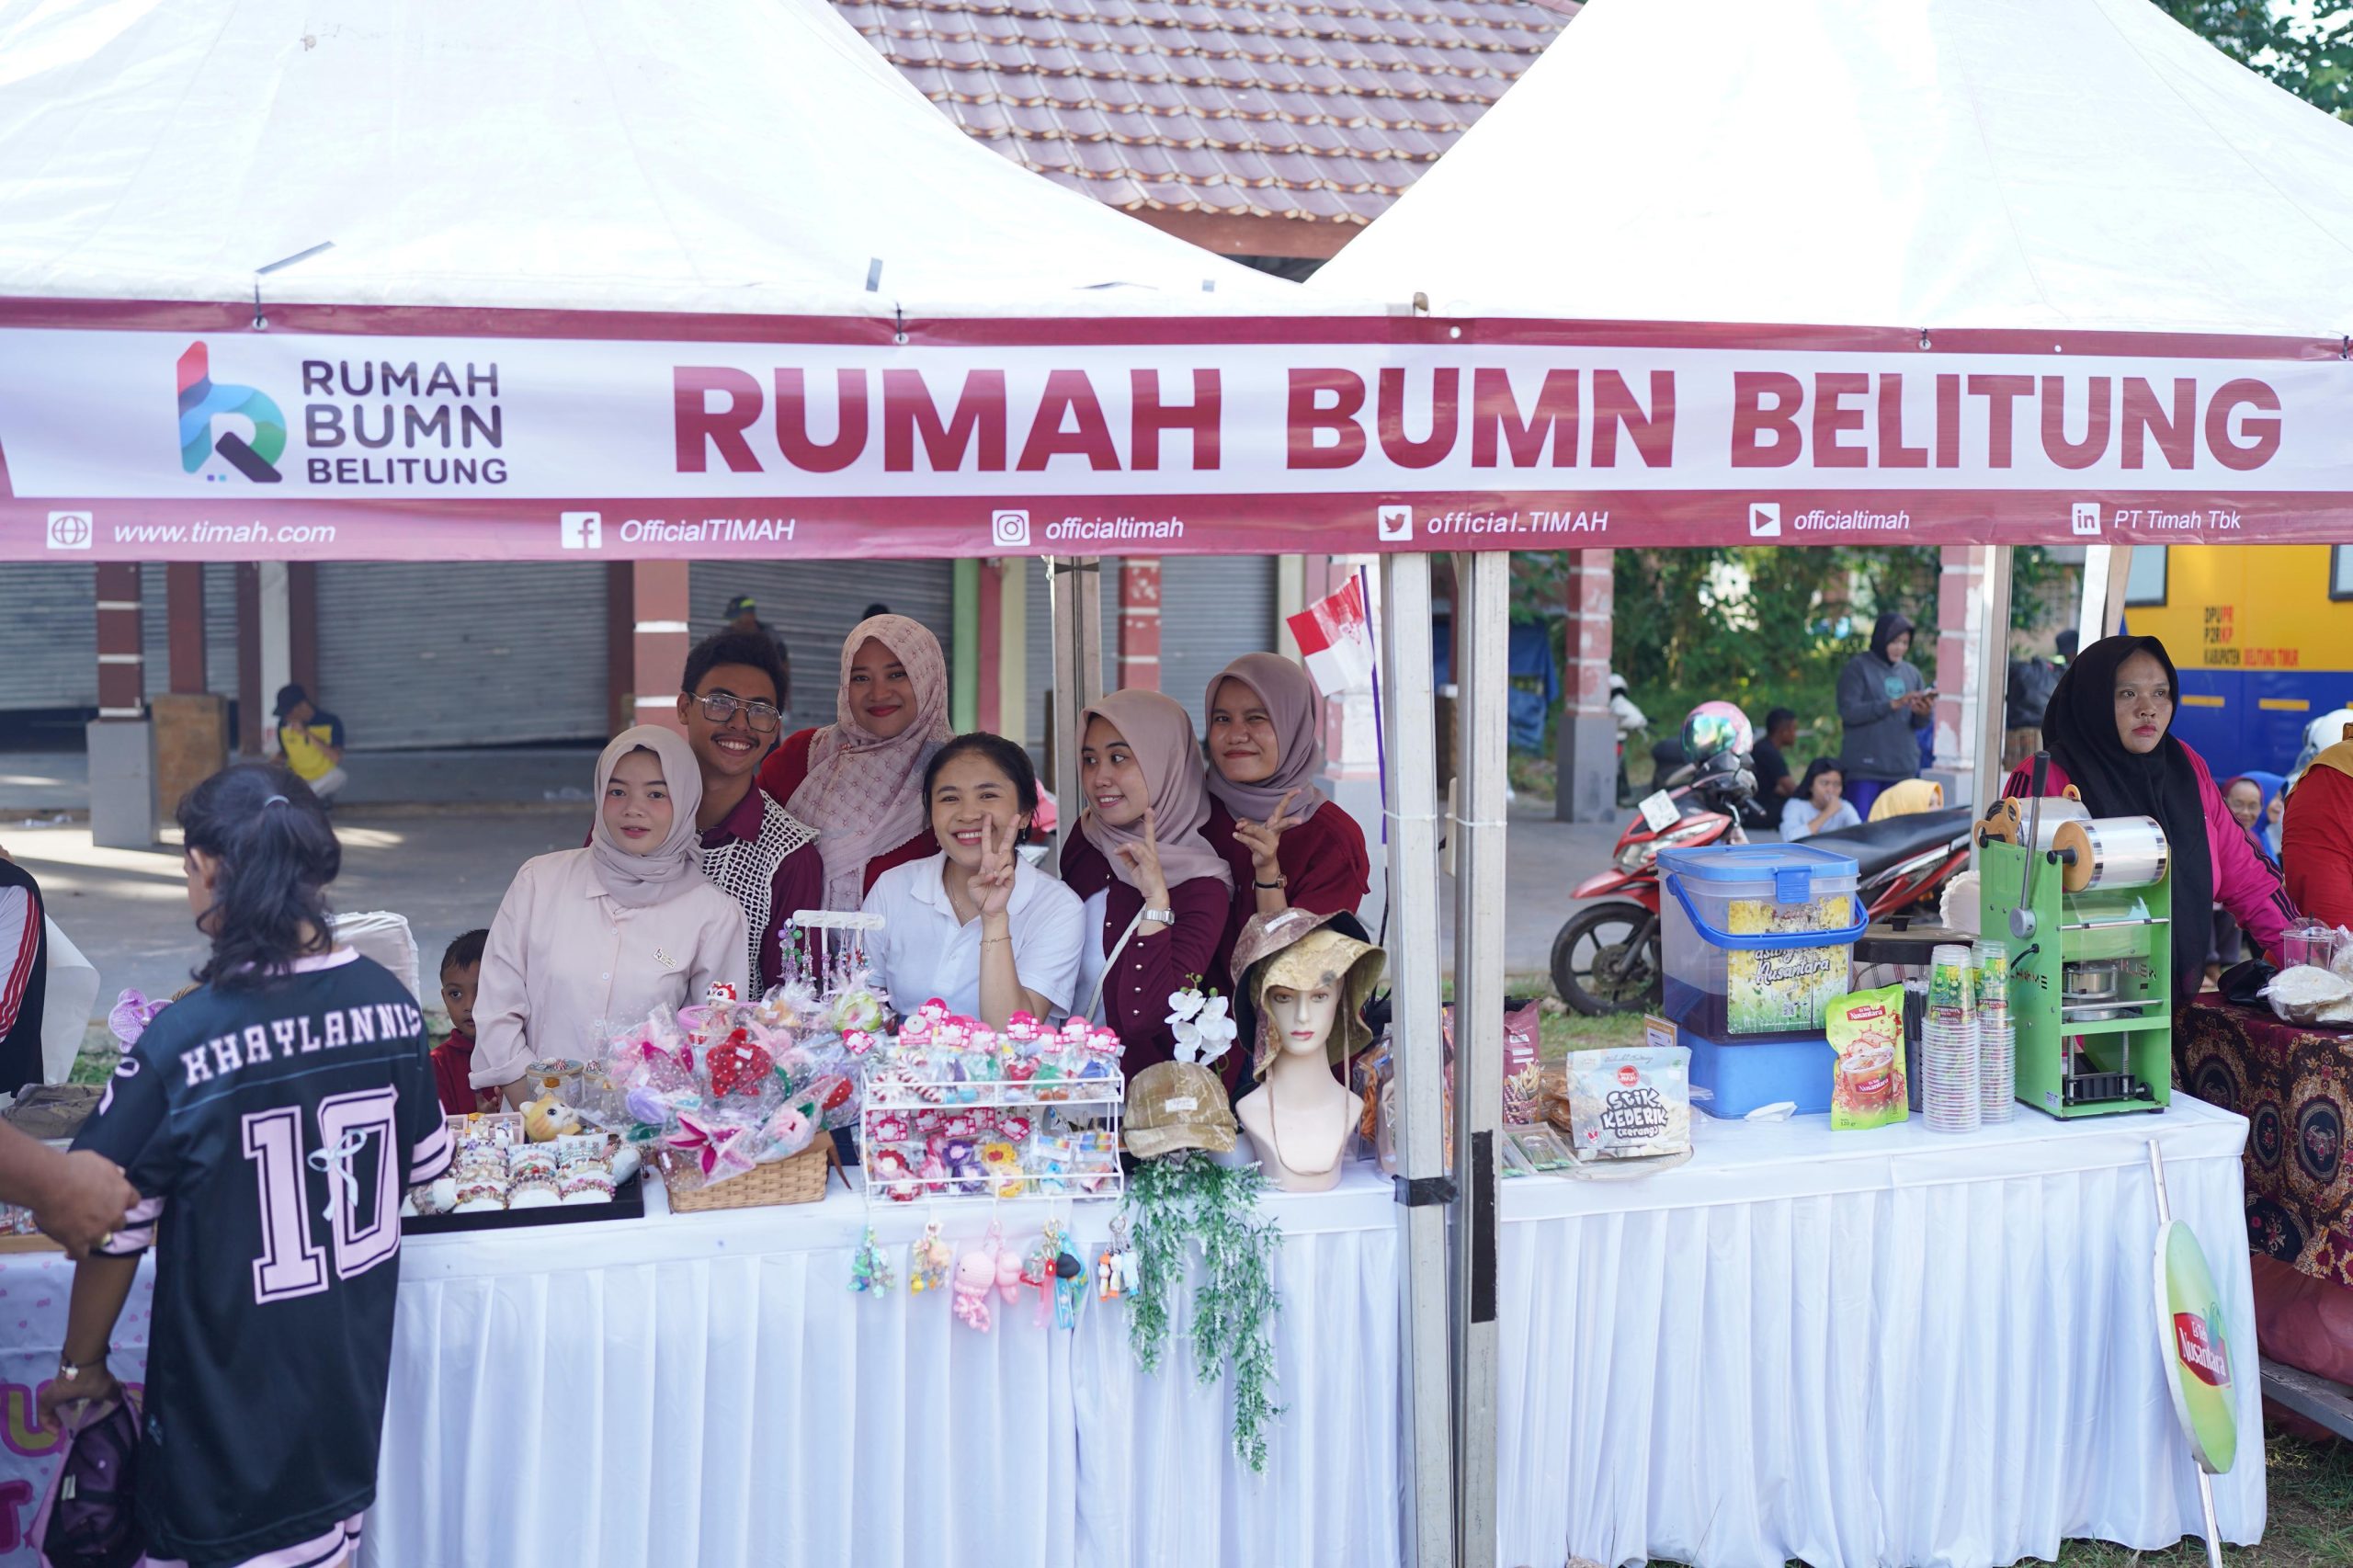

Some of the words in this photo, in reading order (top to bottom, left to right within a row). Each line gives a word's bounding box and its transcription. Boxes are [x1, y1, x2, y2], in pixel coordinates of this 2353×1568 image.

[301, 359, 499, 397] RUMAH
[305, 403, 503, 449] BUMN
[673, 366, 1222, 474] RUMAH
[1286, 367, 1677, 470] BUMN
[1731, 370, 2282, 472] BELITUNG
[307, 458, 507, 485] BELITUNG
[114, 520, 335, 543] www.timah.com
[620, 518, 796, 542] OfficialTIMAH
[1045, 517, 1184, 540] officialtimah
[1427, 511, 1608, 534] official_TIMAH
[1794, 510, 1910, 530] officialtimah
[2114, 510, 2143, 528] PT
[2147, 510, 2201, 529] Timah
[2208, 510, 2242, 529] Tbk
[1756, 959, 1830, 985] Nusantara
[1849, 1010, 1882, 1019] Nusantara
[1600, 1105, 1668, 1130] KEDERIK
[241, 1083, 402, 1305] 10
[2179, 1327, 2226, 1377] Nusantara
